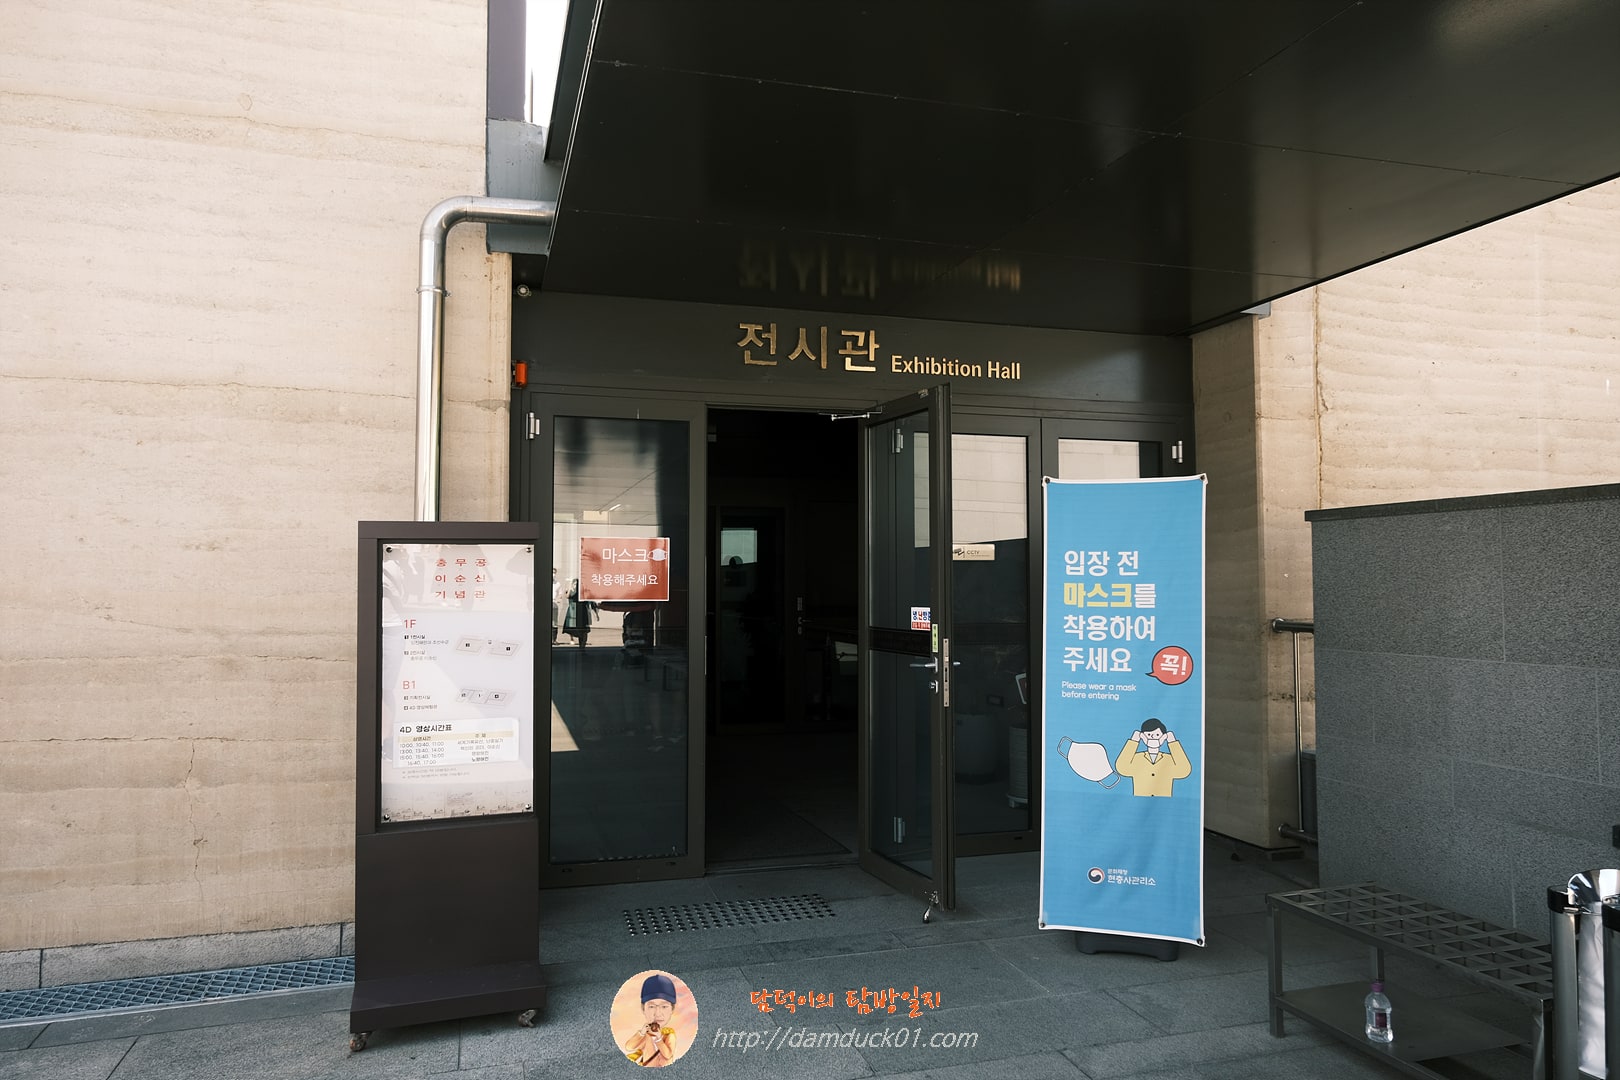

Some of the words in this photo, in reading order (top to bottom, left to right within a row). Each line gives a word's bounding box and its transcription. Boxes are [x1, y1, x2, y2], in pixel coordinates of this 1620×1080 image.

[737, 323, 880, 372] 전시관
[891, 355, 982, 378] Exhibition
[987, 361, 1021, 379] Hall
[602, 547, 649, 564] 마스크
[1064, 550, 1110, 577] 입장
[1116, 550, 1139, 576] 전
[591, 573, 659, 587] 착용해주세요
[1063, 582, 1157, 609] 마스크를
[404, 619, 417, 628] 1F
[1063, 614, 1157, 641] 착용하여
[1063, 647, 1132, 673] 주세요
[1160, 654, 1188, 676] 꼭!
[402, 680, 415, 690] B1
[1061, 680, 1087, 690] Please
[1088, 683, 1107, 691] wear
[1115, 682, 1137, 692] mask
[1061, 690, 1087, 699] before
[1087, 692, 1120, 701] entering
[415, 724, 453, 732] 영상시간표
[1107, 875, 1156, 886] 현충사관리소
